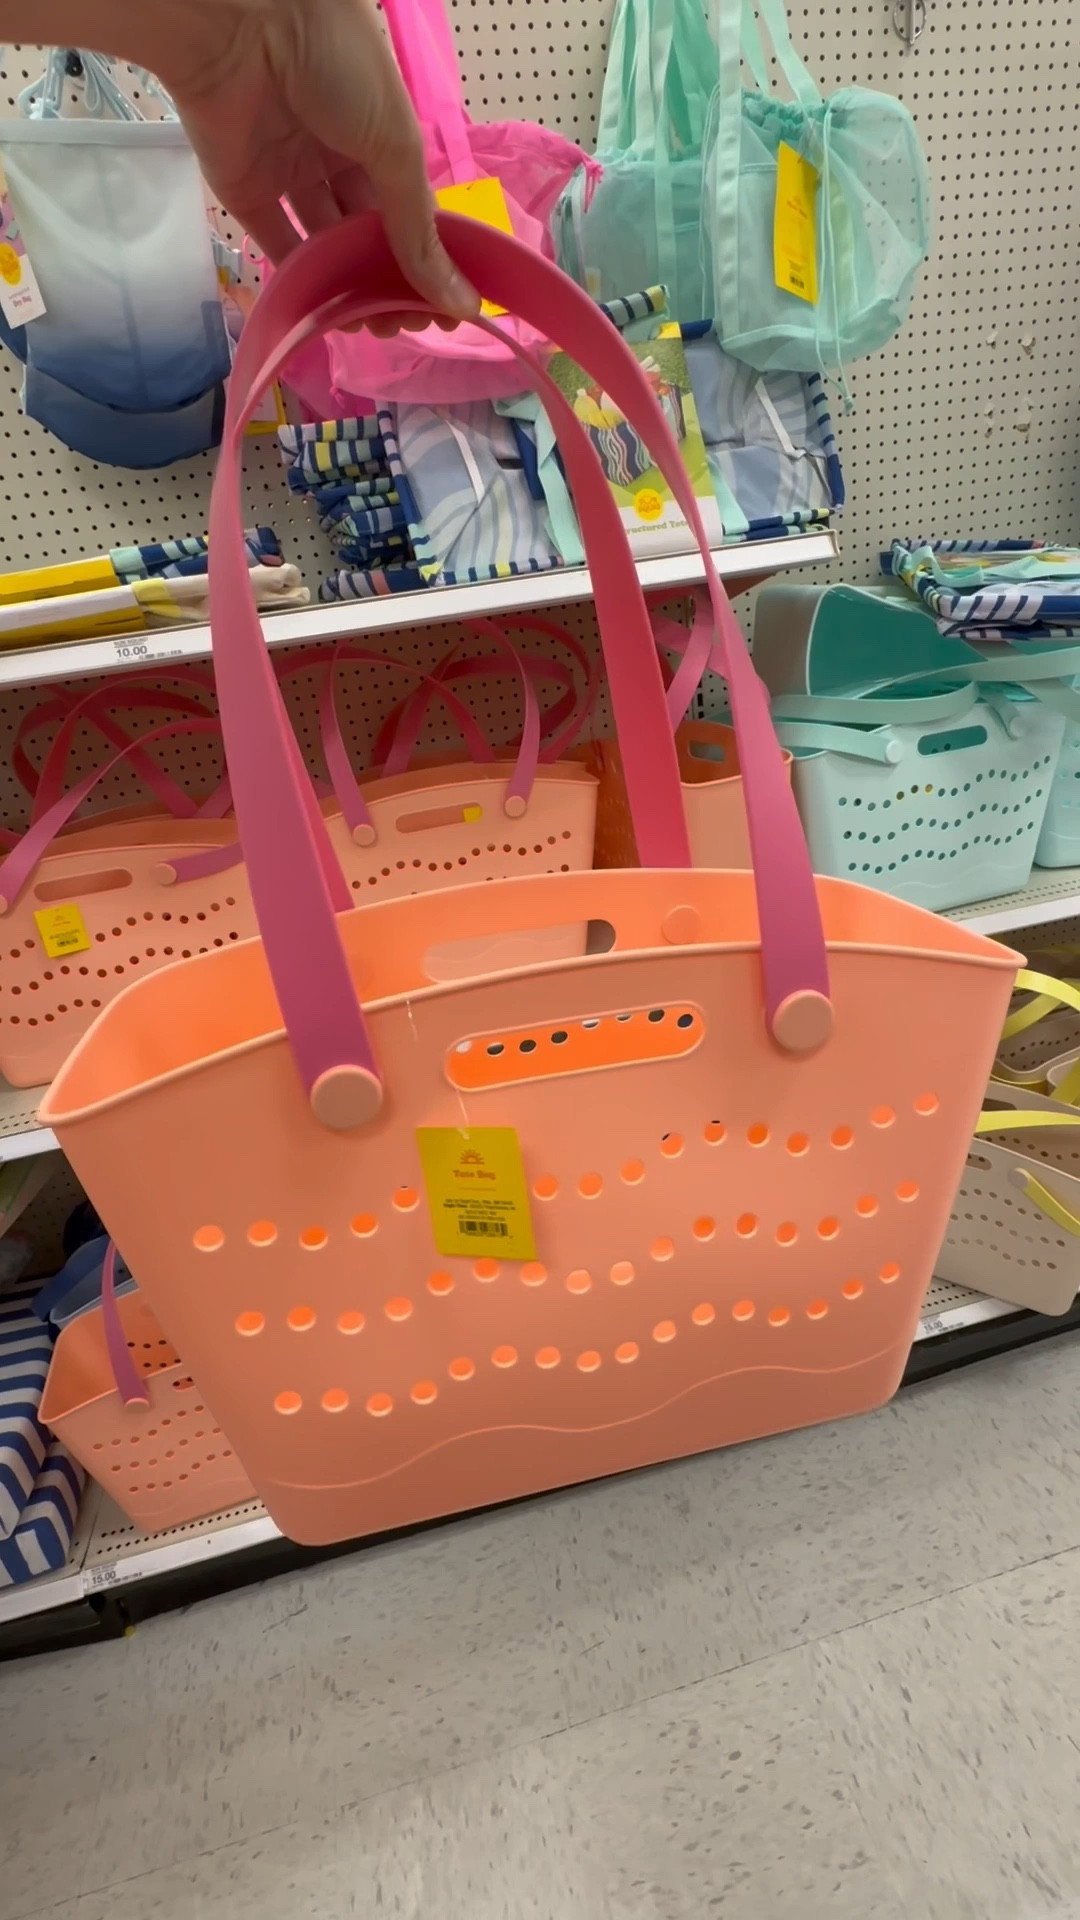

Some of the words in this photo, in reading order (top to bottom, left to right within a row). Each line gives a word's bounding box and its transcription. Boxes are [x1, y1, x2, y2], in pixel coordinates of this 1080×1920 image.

[627, 521, 667, 534] ructured
[116, 645, 148, 658] 10.00
[453, 1169, 475, 1178] Tote
[476, 1170, 496, 1180] Bag
[92, 1570, 116, 1584] 15.00
